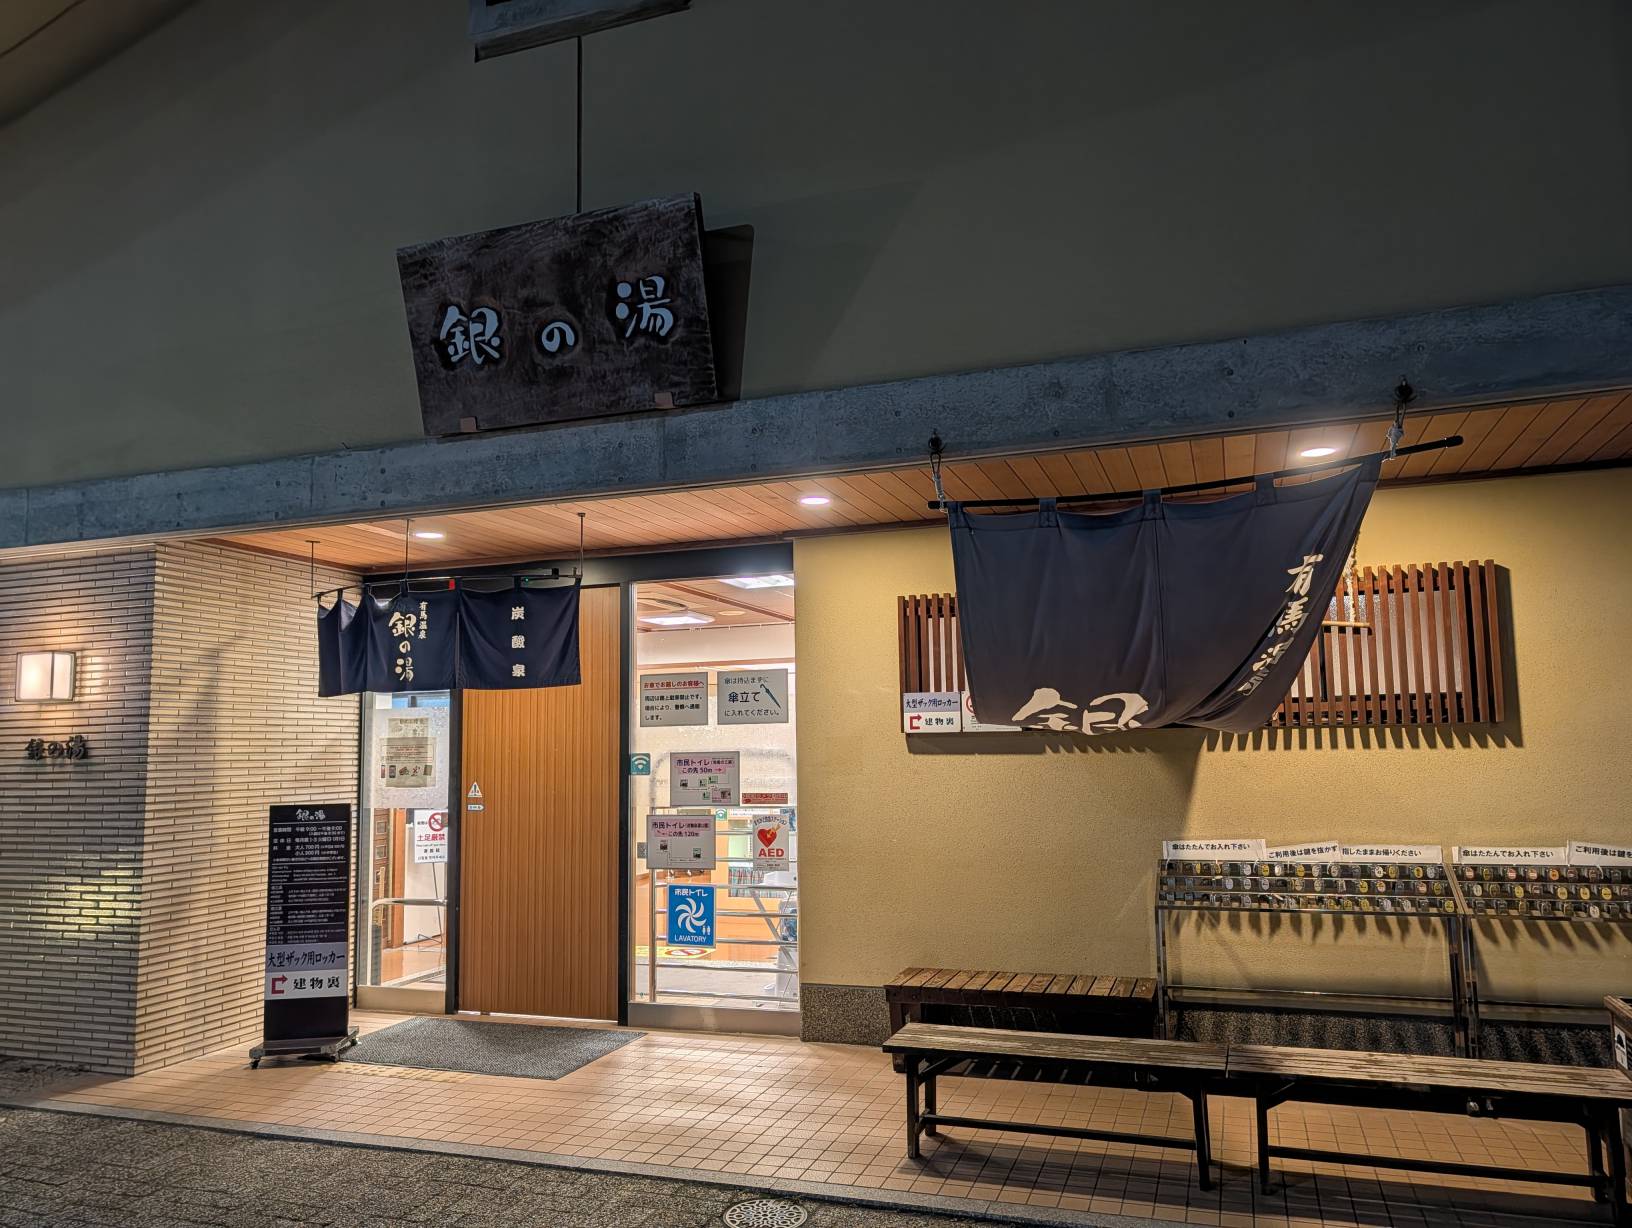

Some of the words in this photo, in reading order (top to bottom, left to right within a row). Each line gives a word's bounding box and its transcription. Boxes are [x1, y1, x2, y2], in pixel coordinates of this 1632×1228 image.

[439, 275, 675, 365] 銀の湯
[388, 611, 417, 682] 銀の湯
[511, 606, 526, 678] 炭酸泉
[728, 691, 761, 704] 傘立て
[906, 697, 959, 709] 大型ザック用ロッカー
[724, 709, 780, 717] に入れてください。
[676, 759, 710, 767] 市民トイレ
[652, 821, 685, 829] 市民トイレ
[416, 833, 446, 842] 土足厳禁
[1171, 842, 1251, 851] 傘はたたんでお入れ下さい
[758, 848, 785, 858] AED
[1462, 849, 1554, 858] 傘はたたんでお入れ下さい
[674, 888, 709, 897] 市民トイレ
[674, 934, 707, 943] LAVATORY
[268, 950, 345, 968] 大型ザック用ロッカー
